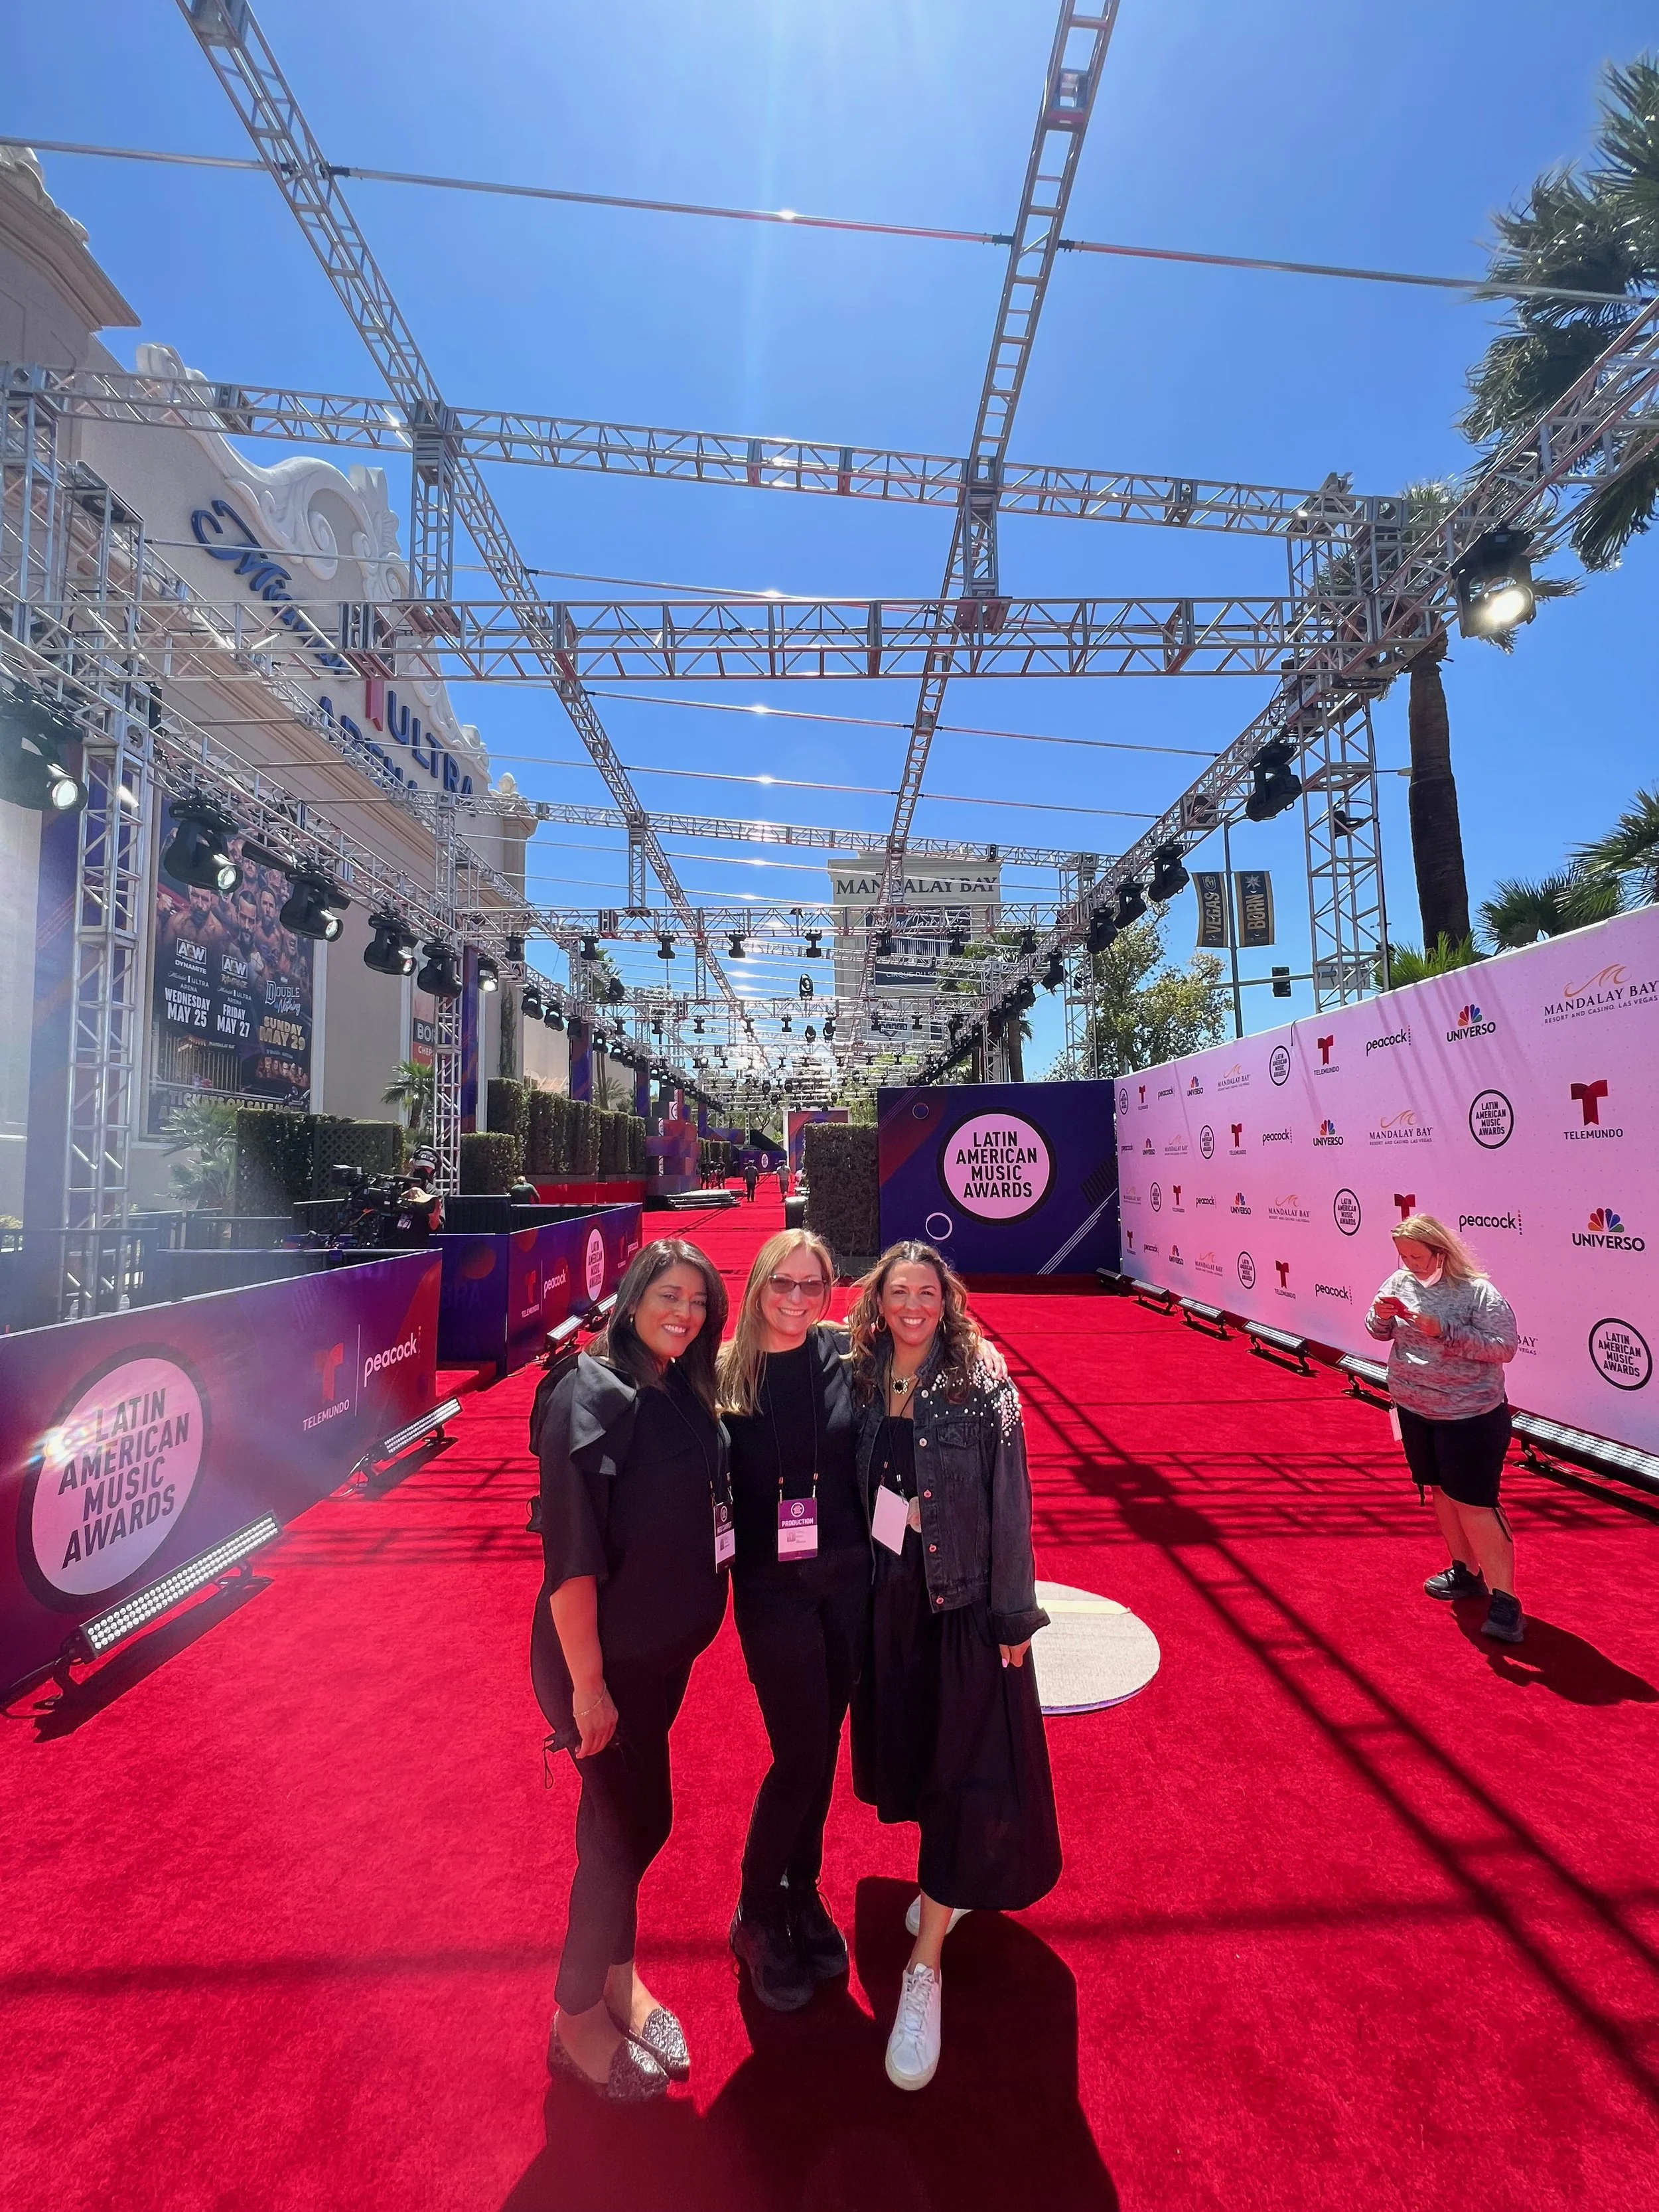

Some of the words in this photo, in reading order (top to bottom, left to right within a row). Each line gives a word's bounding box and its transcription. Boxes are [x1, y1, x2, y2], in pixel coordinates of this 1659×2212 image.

[960, 877, 997, 893] BAY
[1204, 892, 1221, 934] VEGAS
[1245, 893, 1265, 930] BORN
[179, 942, 205, 961] AEW
[175, 959, 207, 974] DYNAMITE
[224, 958, 246, 976] AEW
[180, 983, 198, 994] ARENA
[191, 977, 210, 988] ULTRA
[165, 987, 211, 1011] WEDNESDAY
[236, 990, 252, 1001] ULTRA
[1544, 988, 1624, 1016] MANDALAY
[1629, 980, 1659, 997] BAY
[167, 1001, 194, 1023] MAY
[194, 1009, 208, 1027] 25
[223, 1003, 246, 1021] FRIDAY
[277, 997, 301, 1017] Nothing
[1544, 1014, 1568, 1024] RESORT
[1634, 995, 1658, 1005] VEGAS
[217, 1015, 238, 1034] MAY
[239, 1021, 251, 1038] 27
[263, 1015, 303, 1036] SUNDAY
[1447, 1021, 1496, 1043] UNIVERSO
[259, 1025, 289, 1047] MAY
[291, 1035, 306, 1051] 29
[1366, 1028, 1407, 1057] peacock
[1272, 1058, 1287, 1067] AMERICAN
[1313, 1066, 1340, 1076] TELEMUNDO
[1217, 1076, 1241, 1088] MANDALAY
[1480, 1101, 1498, 1111] LATIN
[1475, 1109, 1506, 1120] AMERICAN
[1480, 1118, 1501, 1127] MUSIC
[973, 1131, 1018, 1147] LATIN
[1262, 1128, 1290, 1146] peacock
[1369, 1128, 1413, 1140] MANDALAY
[1416, 1127, 1433, 1137] BAY
[1479, 1126, 1505, 1136] AWARDS
[1563, 1128, 1623, 1140] TELEMUNDO
[1313, 1136, 1344, 1147] UNIVERSO
[956, 1147, 1037, 1165] AMERICAN
[971, 1165, 1023, 1181] MUSIC
[963, 1181, 1033, 1199] AWARDS
[1196, 1196, 1215, 1209] peacock
[1230, 1207, 1252, 1215] UNIVERSO
[1268, 1207, 1298, 1217] MANDALAY
[1299, 1209, 1310, 1218] BAY
[1459, 1212, 1517, 1232] peacock
[1571, 1232, 1645, 1252] UNIVERSO
[589, 1251, 603, 1266] AMERICAN
[591, 1264, 600, 1275] MUSIC
[589, 1275, 601, 1289] AWARDS
[522, 1305, 539, 1317] TELEMUNDO
[544, 1270, 566, 1299] peacock
[1274, 1288, 1296, 1299] TELEMUNDO
[1315, 1283, 1349, 1300] peacock
[1605, 1331, 1630, 1345] LATIN
[1598, 1340, 1641, 1357] AMERICAN
[1606, 1351, 1634, 1366] MUSIC
[1603, 1361, 1640, 1377] AWARDS
[303, 1399, 350, 1432] TELEMUNDO
[364, 1333, 417, 1388] peacock
[96, 1388, 167, 1443] LATIN
[58, 1413, 190, 1496] AMERICAN
[83, 1459, 167, 1522] MUSIC
[61, 1484, 176, 1571] AWARDS
[782, 1518, 814, 1526] PRODUCTION
